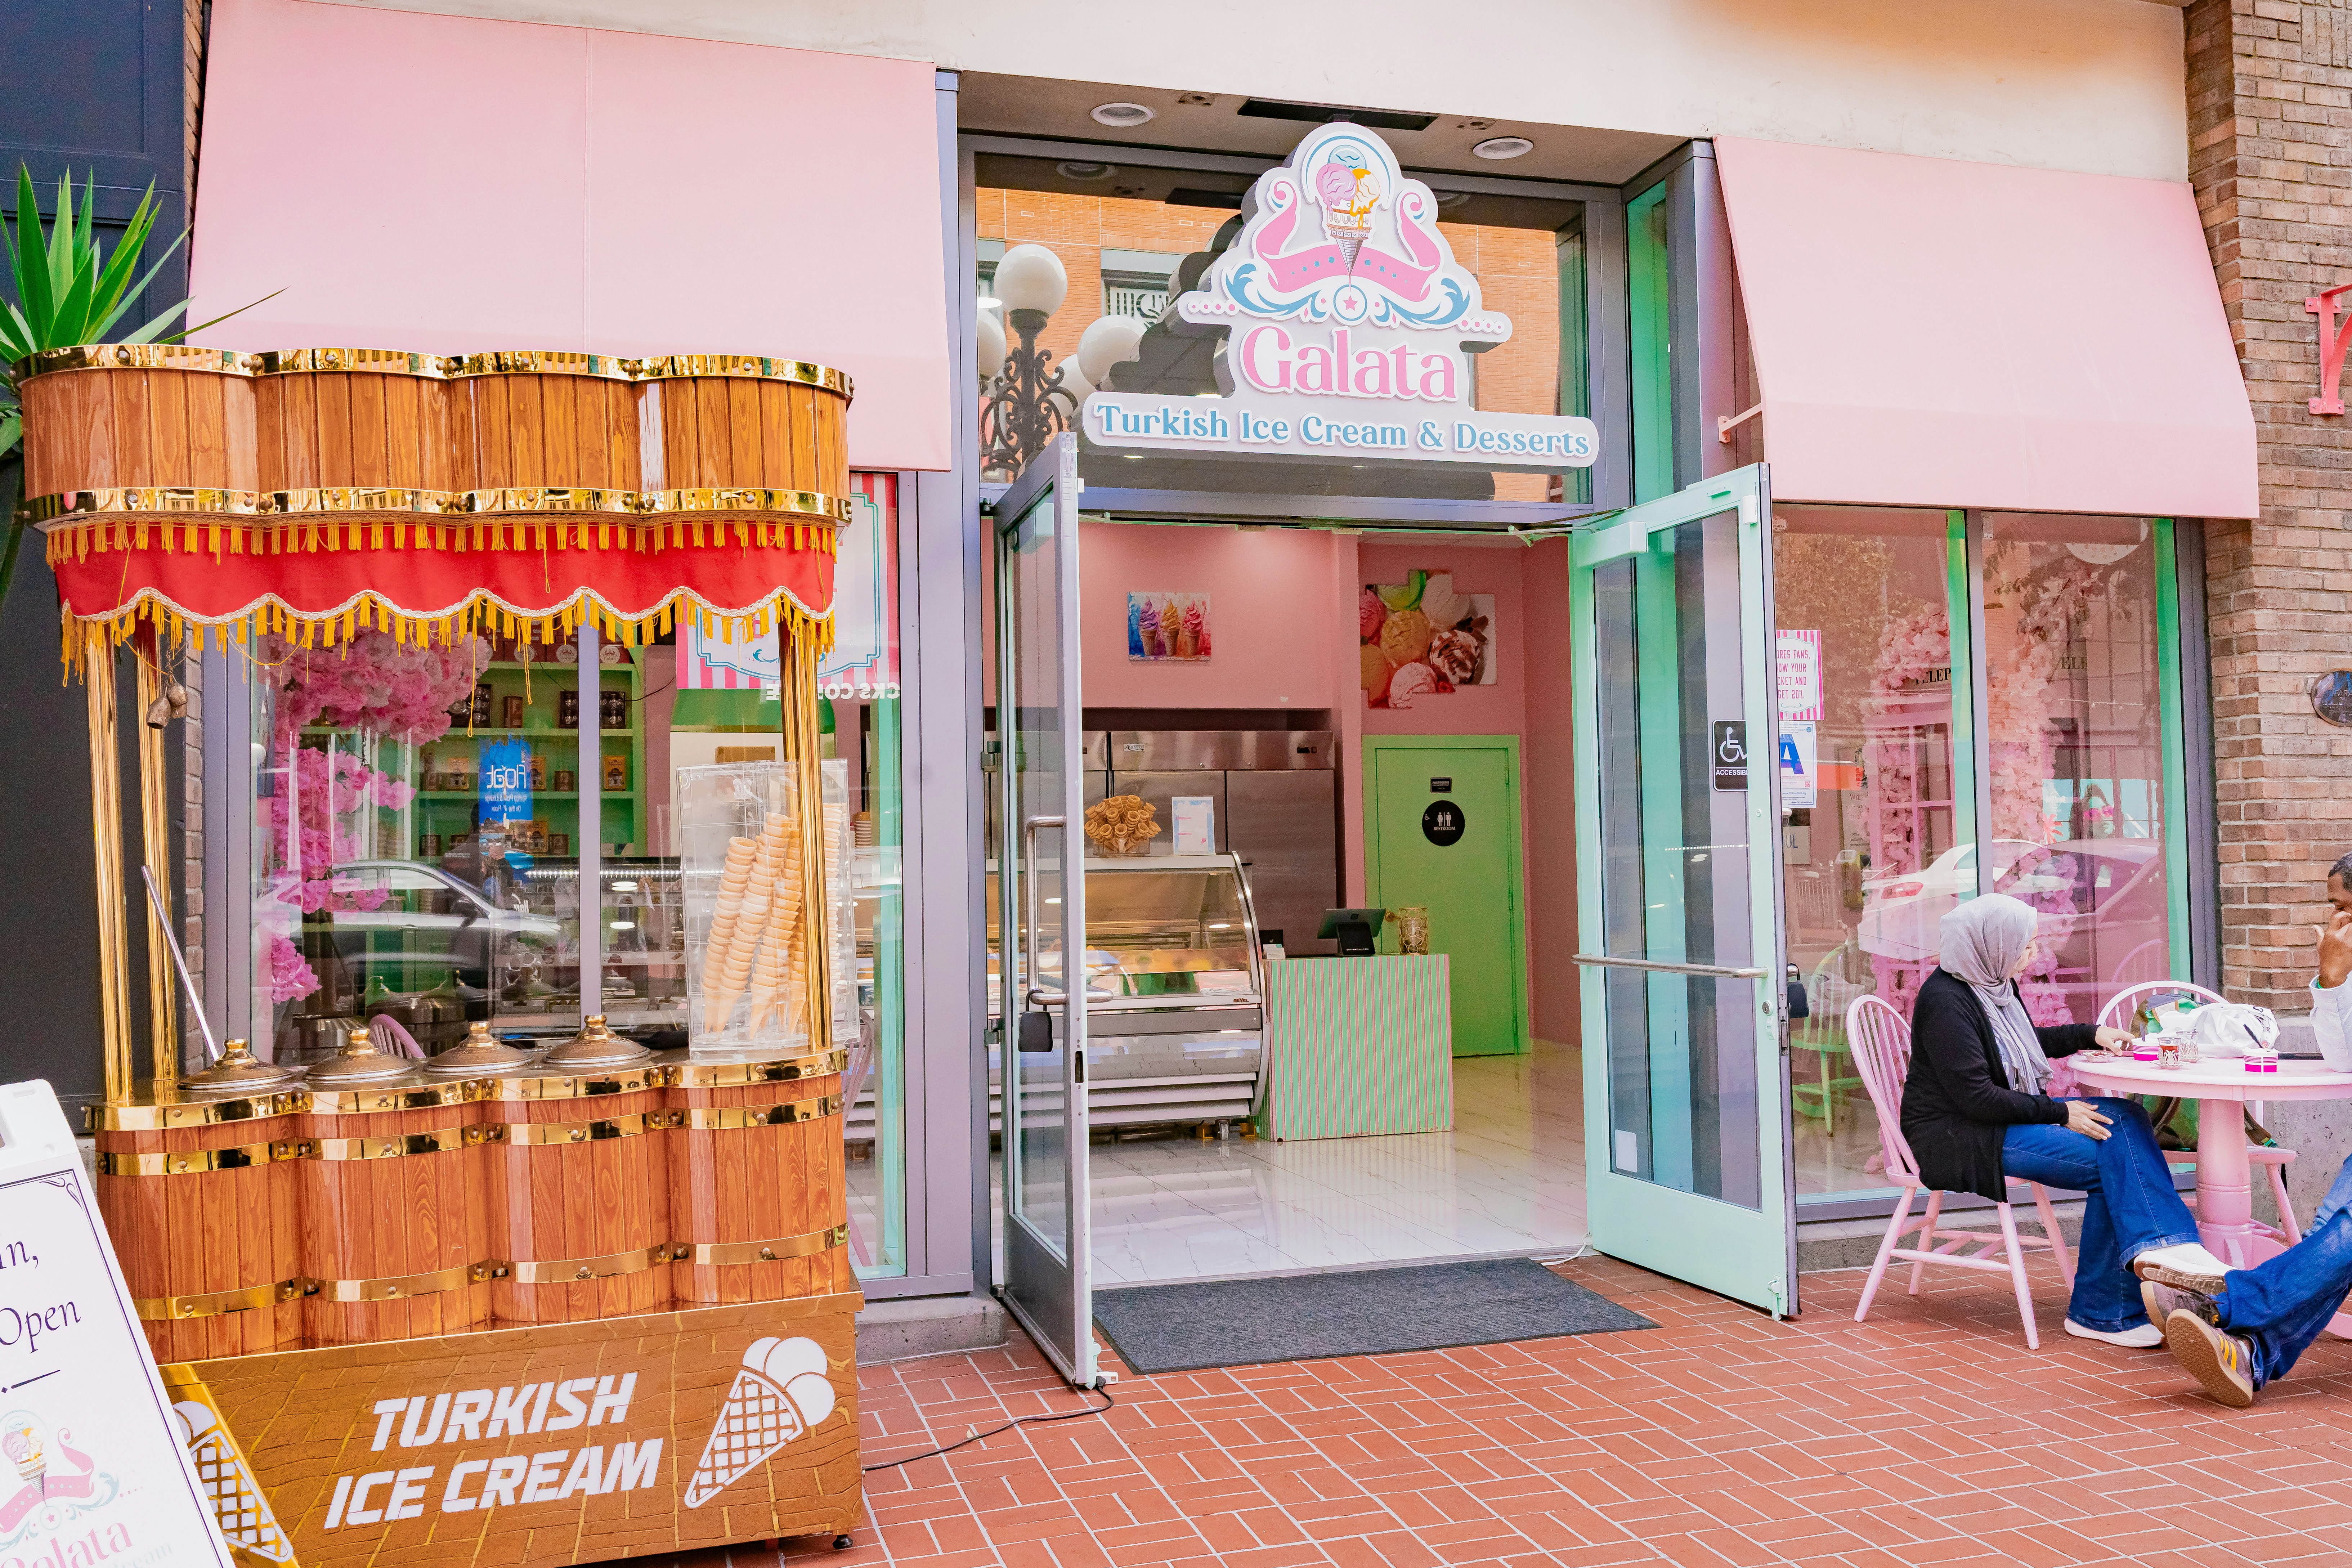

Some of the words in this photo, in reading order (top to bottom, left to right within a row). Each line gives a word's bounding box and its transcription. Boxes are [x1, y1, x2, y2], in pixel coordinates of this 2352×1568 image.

[1243, 326, 1456, 398] Galata
[1097, 405, 1228, 438] Turkish
[1242, 412, 1288, 440] Ice
[1303, 416, 1407, 445] Cream
[1420, 421, 1443, 447] &
[1457, 424, 1589, 454] Desserts
[1777, 663, 1788, 672] OW
[1791, 663, 1806, 672] YOUR
[1793, 650, 1811, 660] FANS,
[1778, 690, 1789, 699] GET
[1792, 690, 1804, 699] 20%
[1795, 676, 1807, 685] AND
[1780, 734, 1805, 774] A
[0, 1301, 81, 1354] Open
[372, 1372, 638, 1452] TURKISH
[323, 1465, 435, 1529] ICE
[441, 1438, 664, 1514] CREAM
